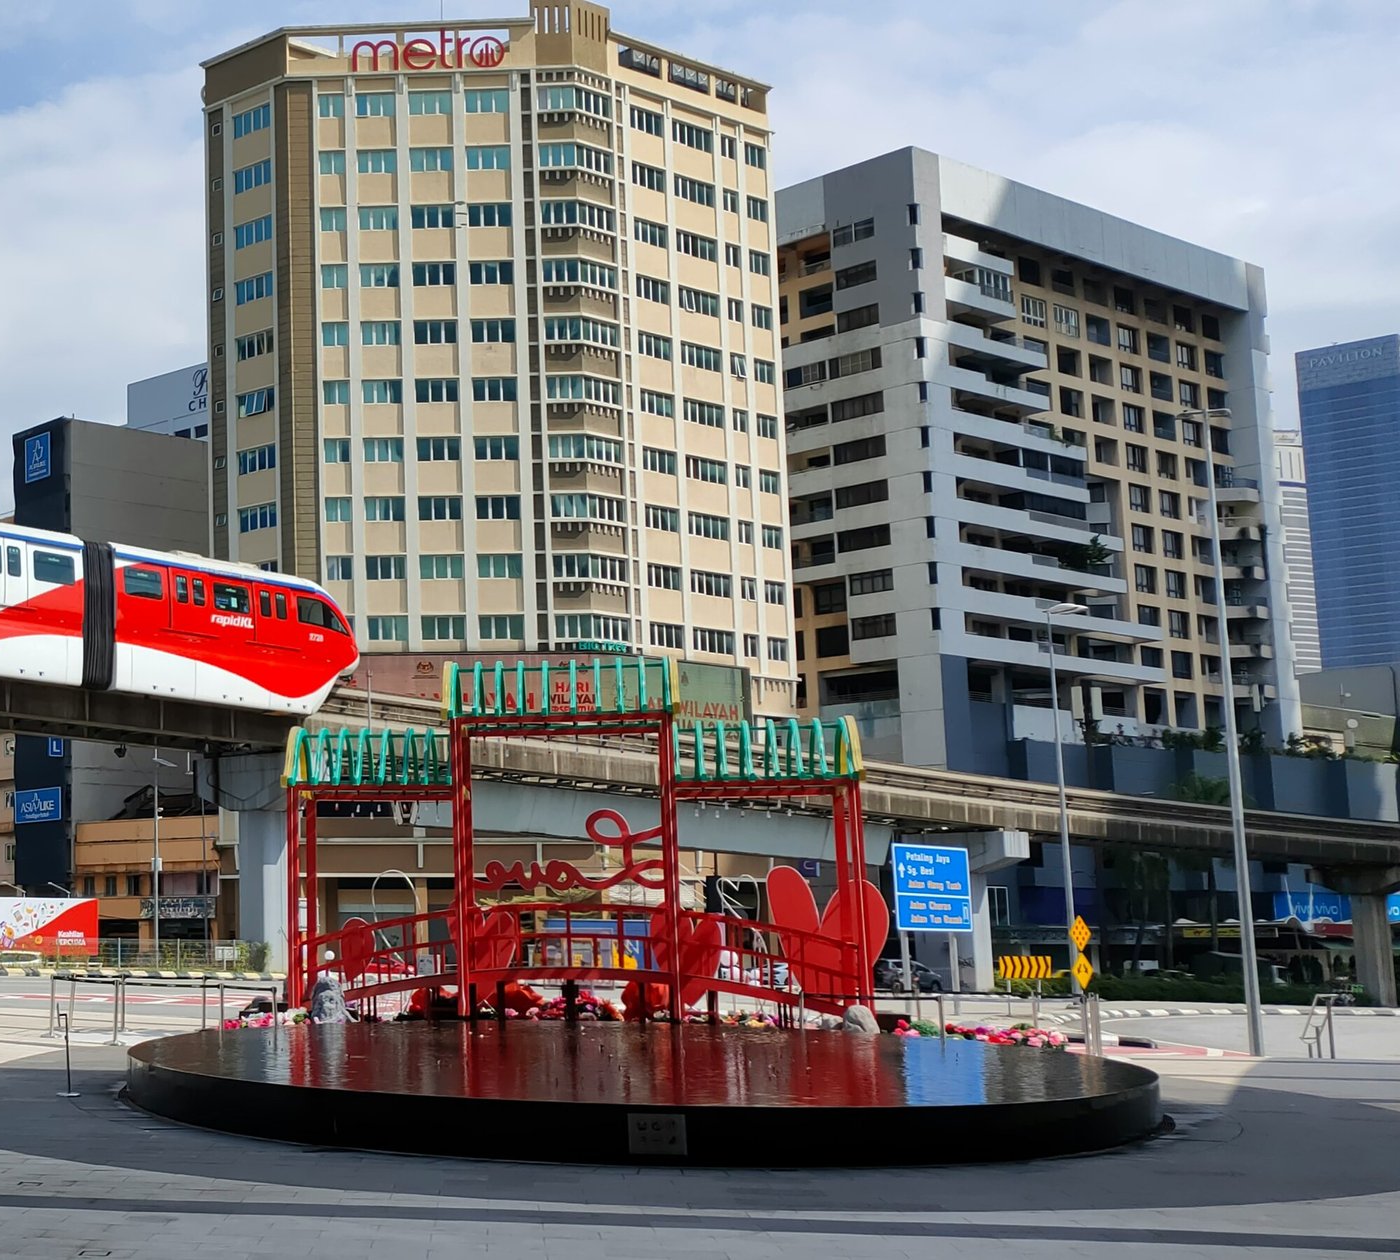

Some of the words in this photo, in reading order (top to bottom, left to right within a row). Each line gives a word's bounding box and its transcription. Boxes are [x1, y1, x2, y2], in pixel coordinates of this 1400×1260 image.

[352, 27, 505, 72] metro
[1309, 346, 1384, 369] PAVILION
[210, 614, 254, 629] rapidKL
[905, 851, 933, 864] Petaling
[936, 854, 950, 864] Jaya
[920, 866, 934, 875] Besi
[1314, 901, 1339, 915] vivo
